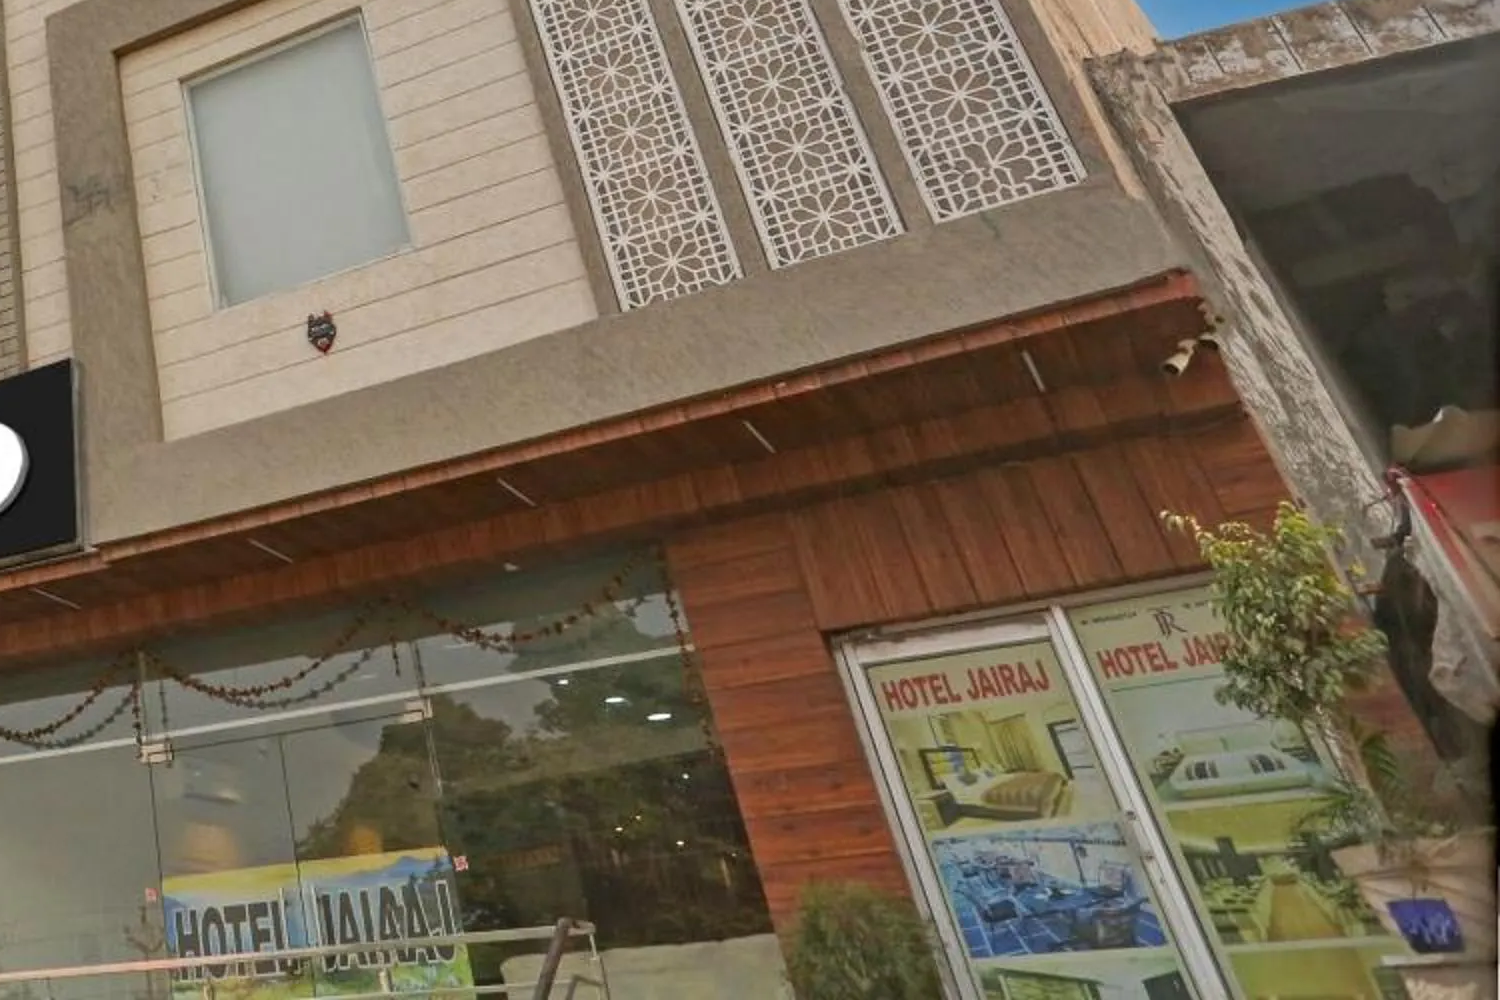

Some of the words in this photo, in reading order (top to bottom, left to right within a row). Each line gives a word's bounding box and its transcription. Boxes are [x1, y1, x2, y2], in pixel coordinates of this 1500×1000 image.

[880, 672, 962, 712] HOTEL
[966, 659, 1050, 700] JAIRAJ
[1096, 641, 1179, 680] HOTEL
[173, 891, 302, 980] HOTEL
